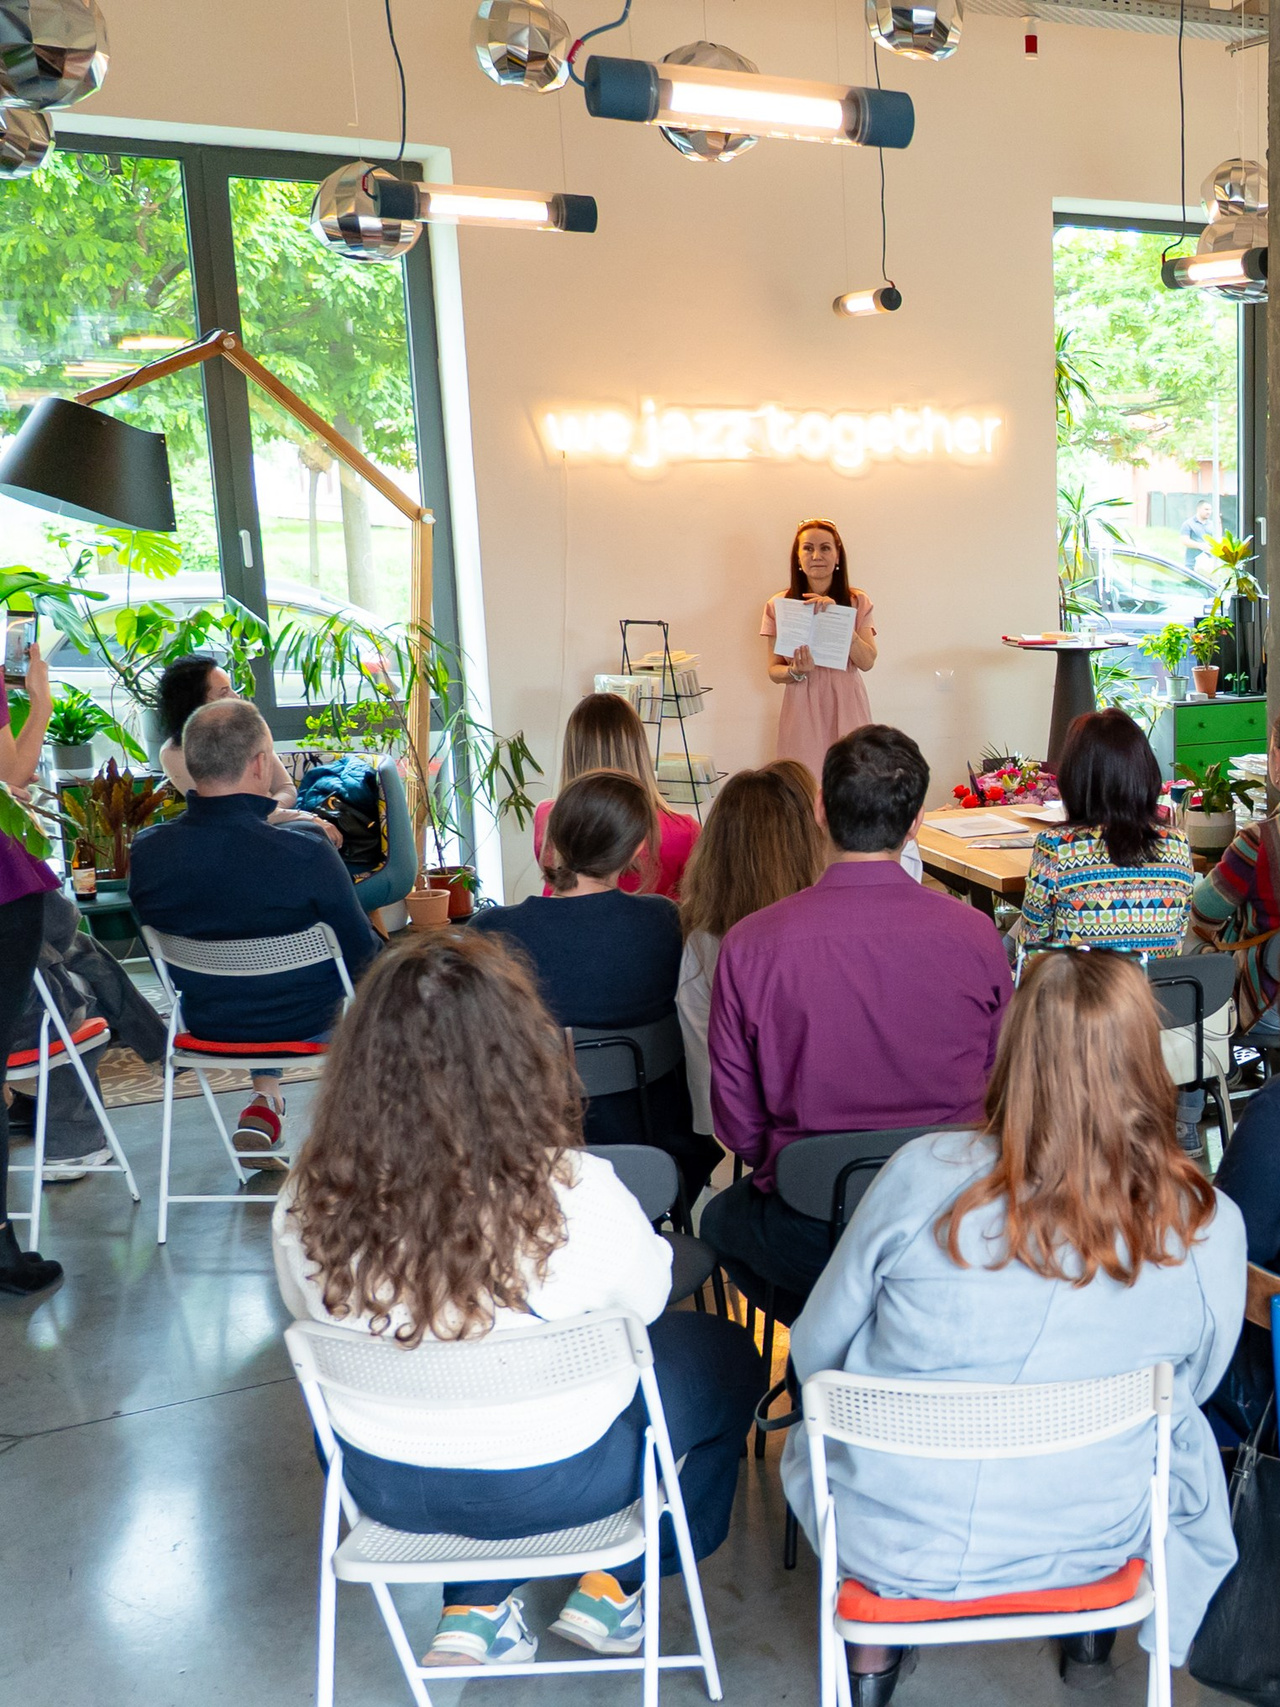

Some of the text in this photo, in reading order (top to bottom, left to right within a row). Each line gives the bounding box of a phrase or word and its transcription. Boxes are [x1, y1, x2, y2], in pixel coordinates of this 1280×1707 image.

[544, 397, 1002, 469] we jazz together
